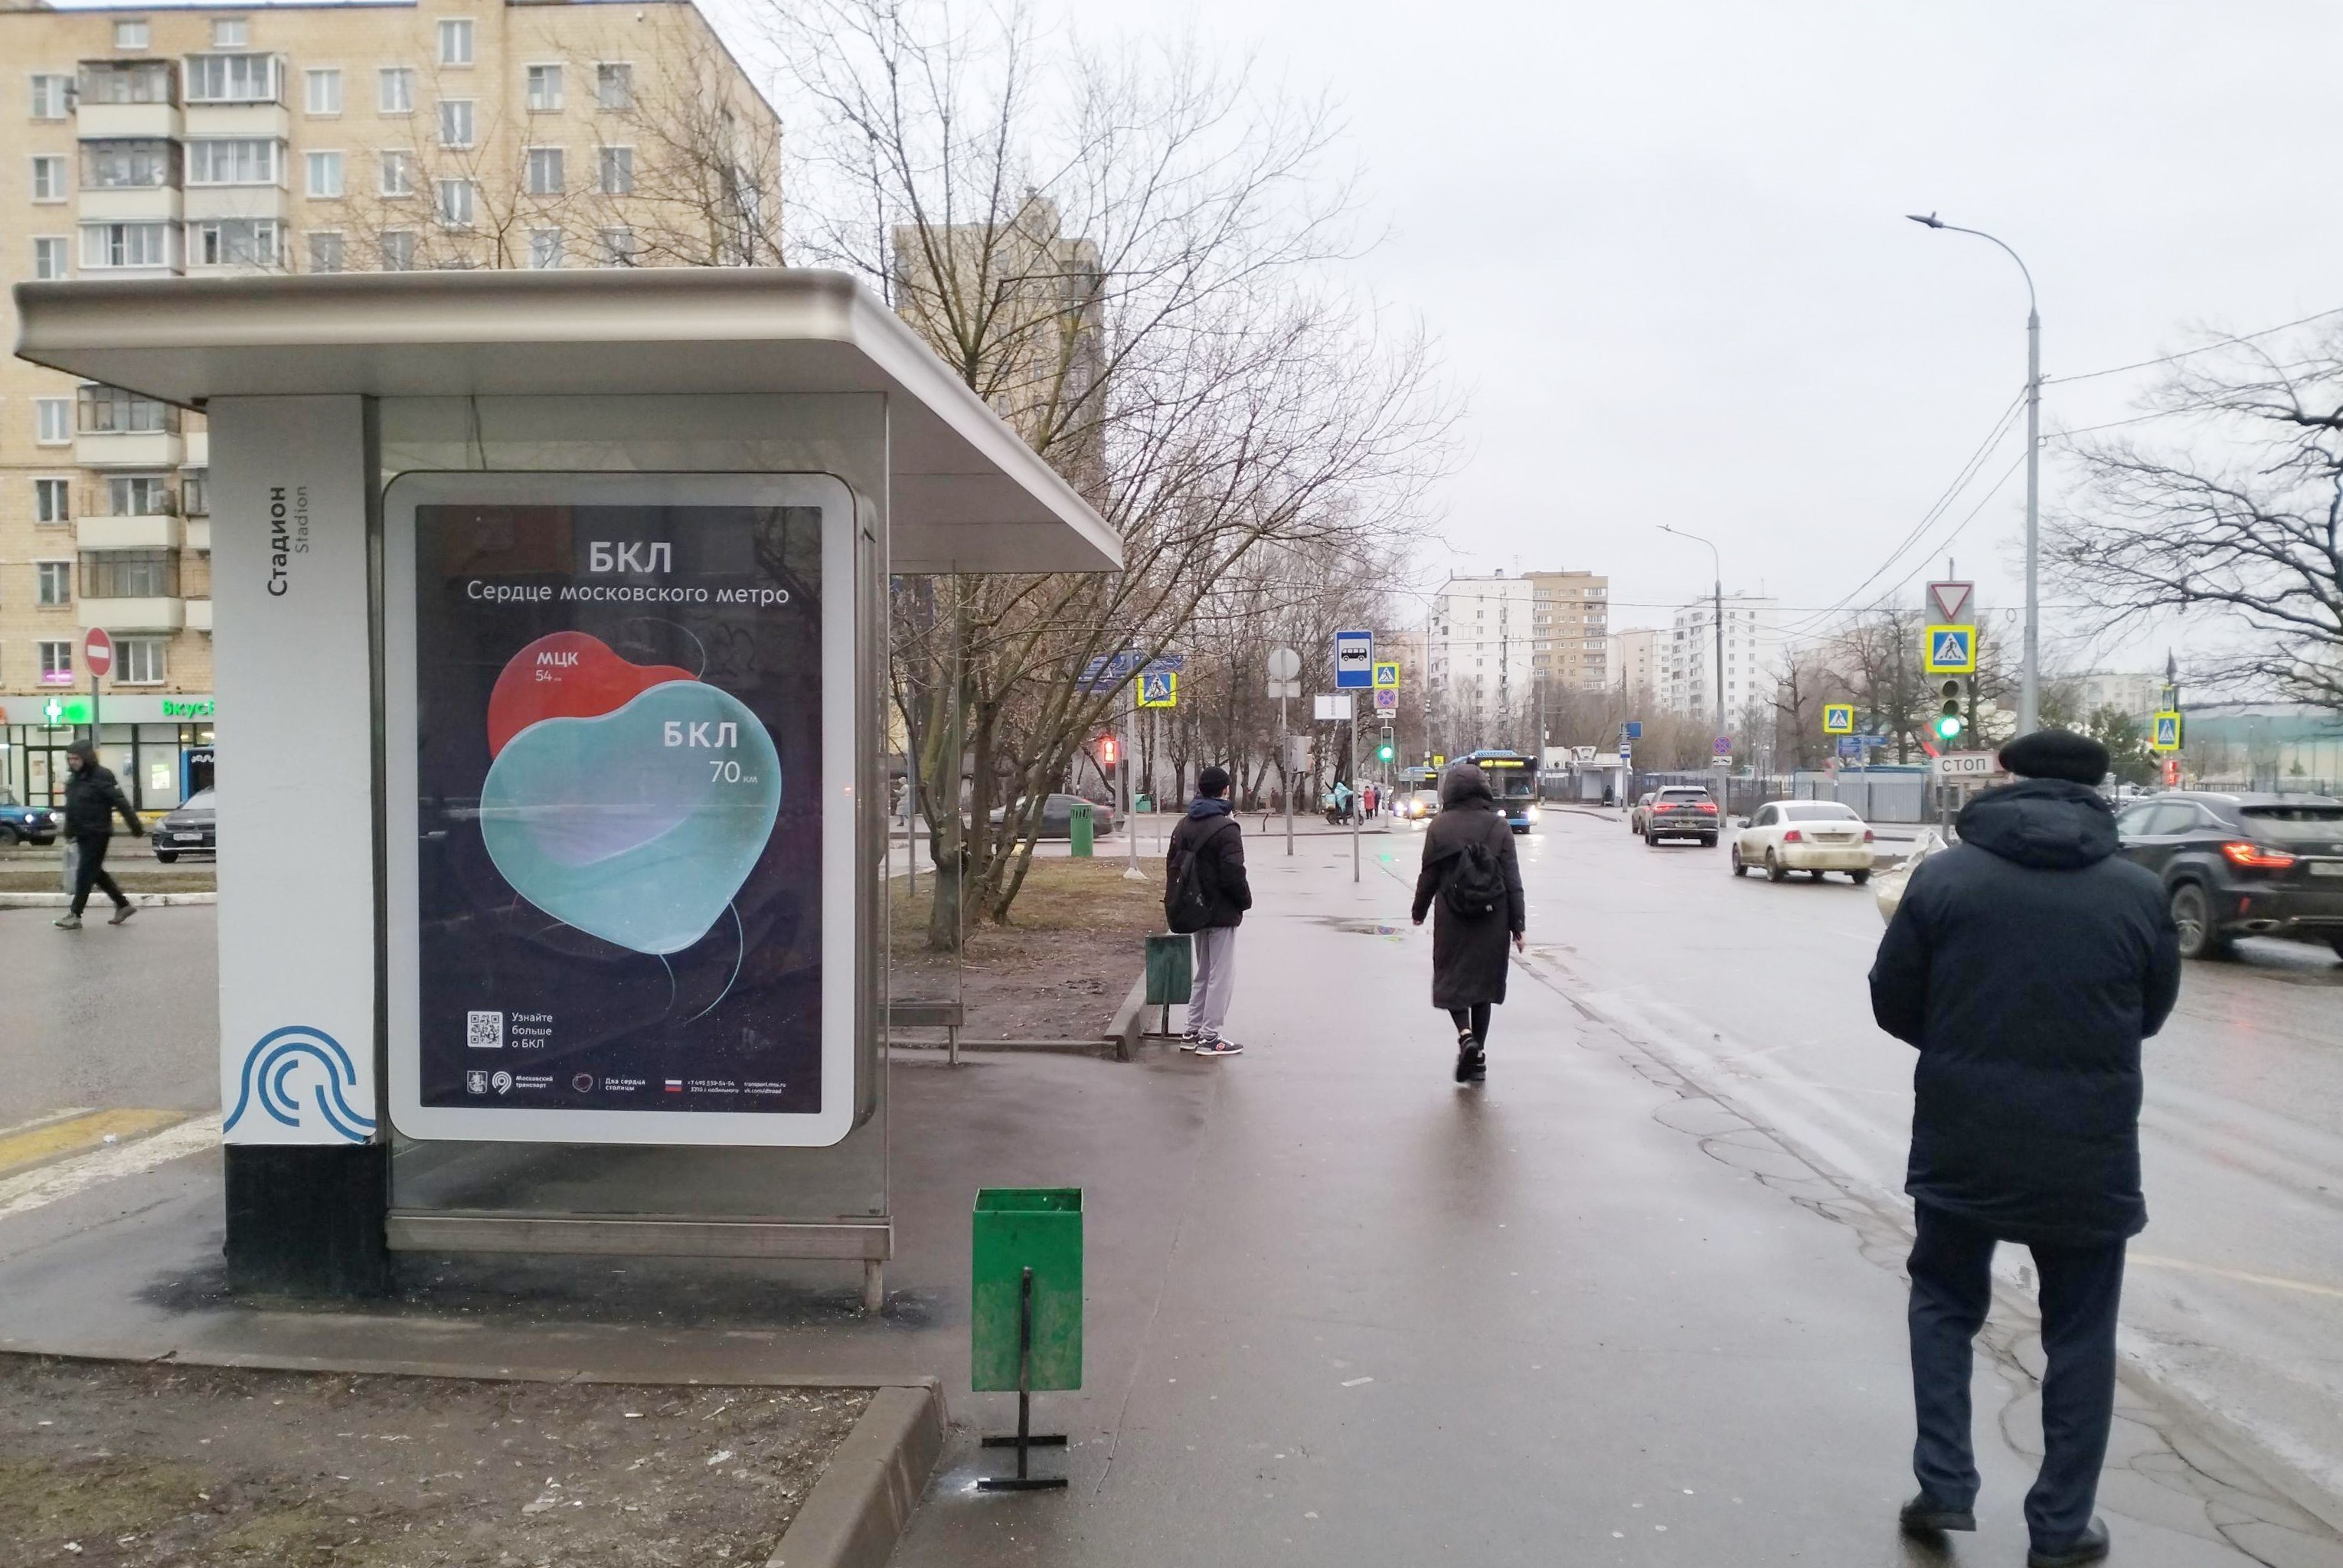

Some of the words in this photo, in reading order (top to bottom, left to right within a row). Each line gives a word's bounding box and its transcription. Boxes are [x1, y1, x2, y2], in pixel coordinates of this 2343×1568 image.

[294, 486, 309, 553] Stadion
[267, 487, 290, 596] Стадион
[590, 541, 671, 573] БКЛ
[467, 580, 552, 603] Сердце
[560, 586, 708, 603] московского
[716, 589, 789, 606] метро
[536, 652, 579, 667] МЦК
[535, 669, 553, 681] 54
[664, 721, 737, 748] БКЛ
[709, 760, 740, 783] 70
[1942, 757, 1986, 773] СТОП
[511, 1012, 553, 1023] Узнайте
[511, 1025, 552, 1036] больше
[521, 1038, 544, 1048] БКЛ
